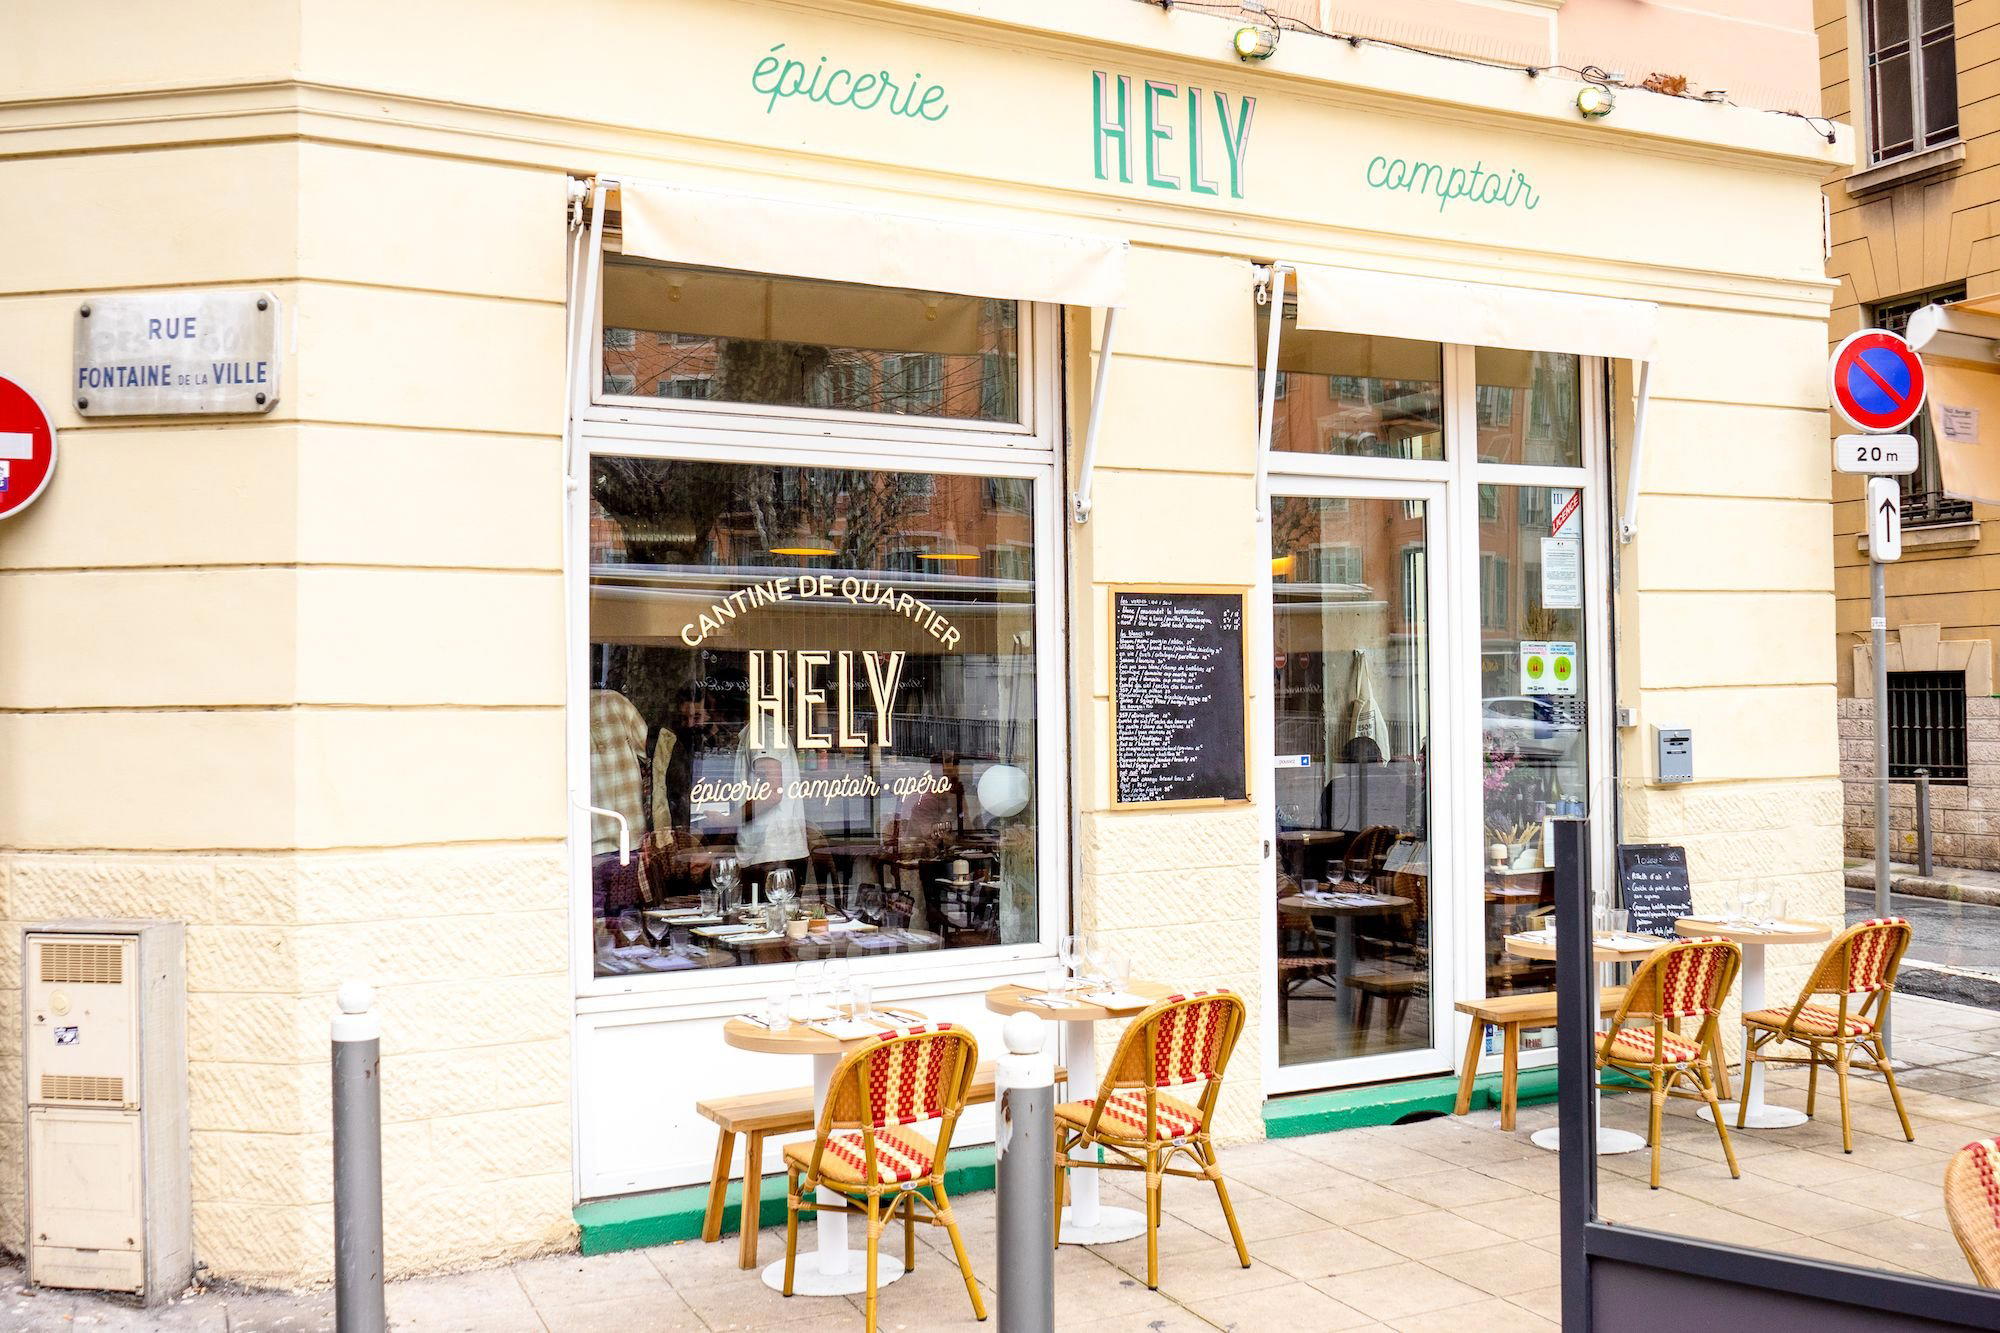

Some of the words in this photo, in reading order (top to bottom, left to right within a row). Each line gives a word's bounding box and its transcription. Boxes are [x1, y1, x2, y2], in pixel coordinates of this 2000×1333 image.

[752, 43, 949, 121] épicerie
[1093, 70, 1256, 199] HELY
[1367, 156, 1540, 213] comptoir
[149, 317, 196, 340] RUE
[78, 365, 172, 389] FONTAINE
[178, 374, 190, 386] DE
[195, 373, 208, 386] LA
[212, 361, 267, 384] VILLE
[1857, 447, 1882, 462] 20
[1886, 452, 1898, 462] m
[1552, 493, 1580, 532] LICENCE
[681, 577, 793, 647] CANTINE
[799, 575, 834, 598] DE
[842, 576, 961, 650] QUARTIER
[749, 650, 906, 750] HELY
[690, 776, 772, 812] épicerie
[787, 774, 880, 806] comptoir
[893, 770, 952, 804] apéro
